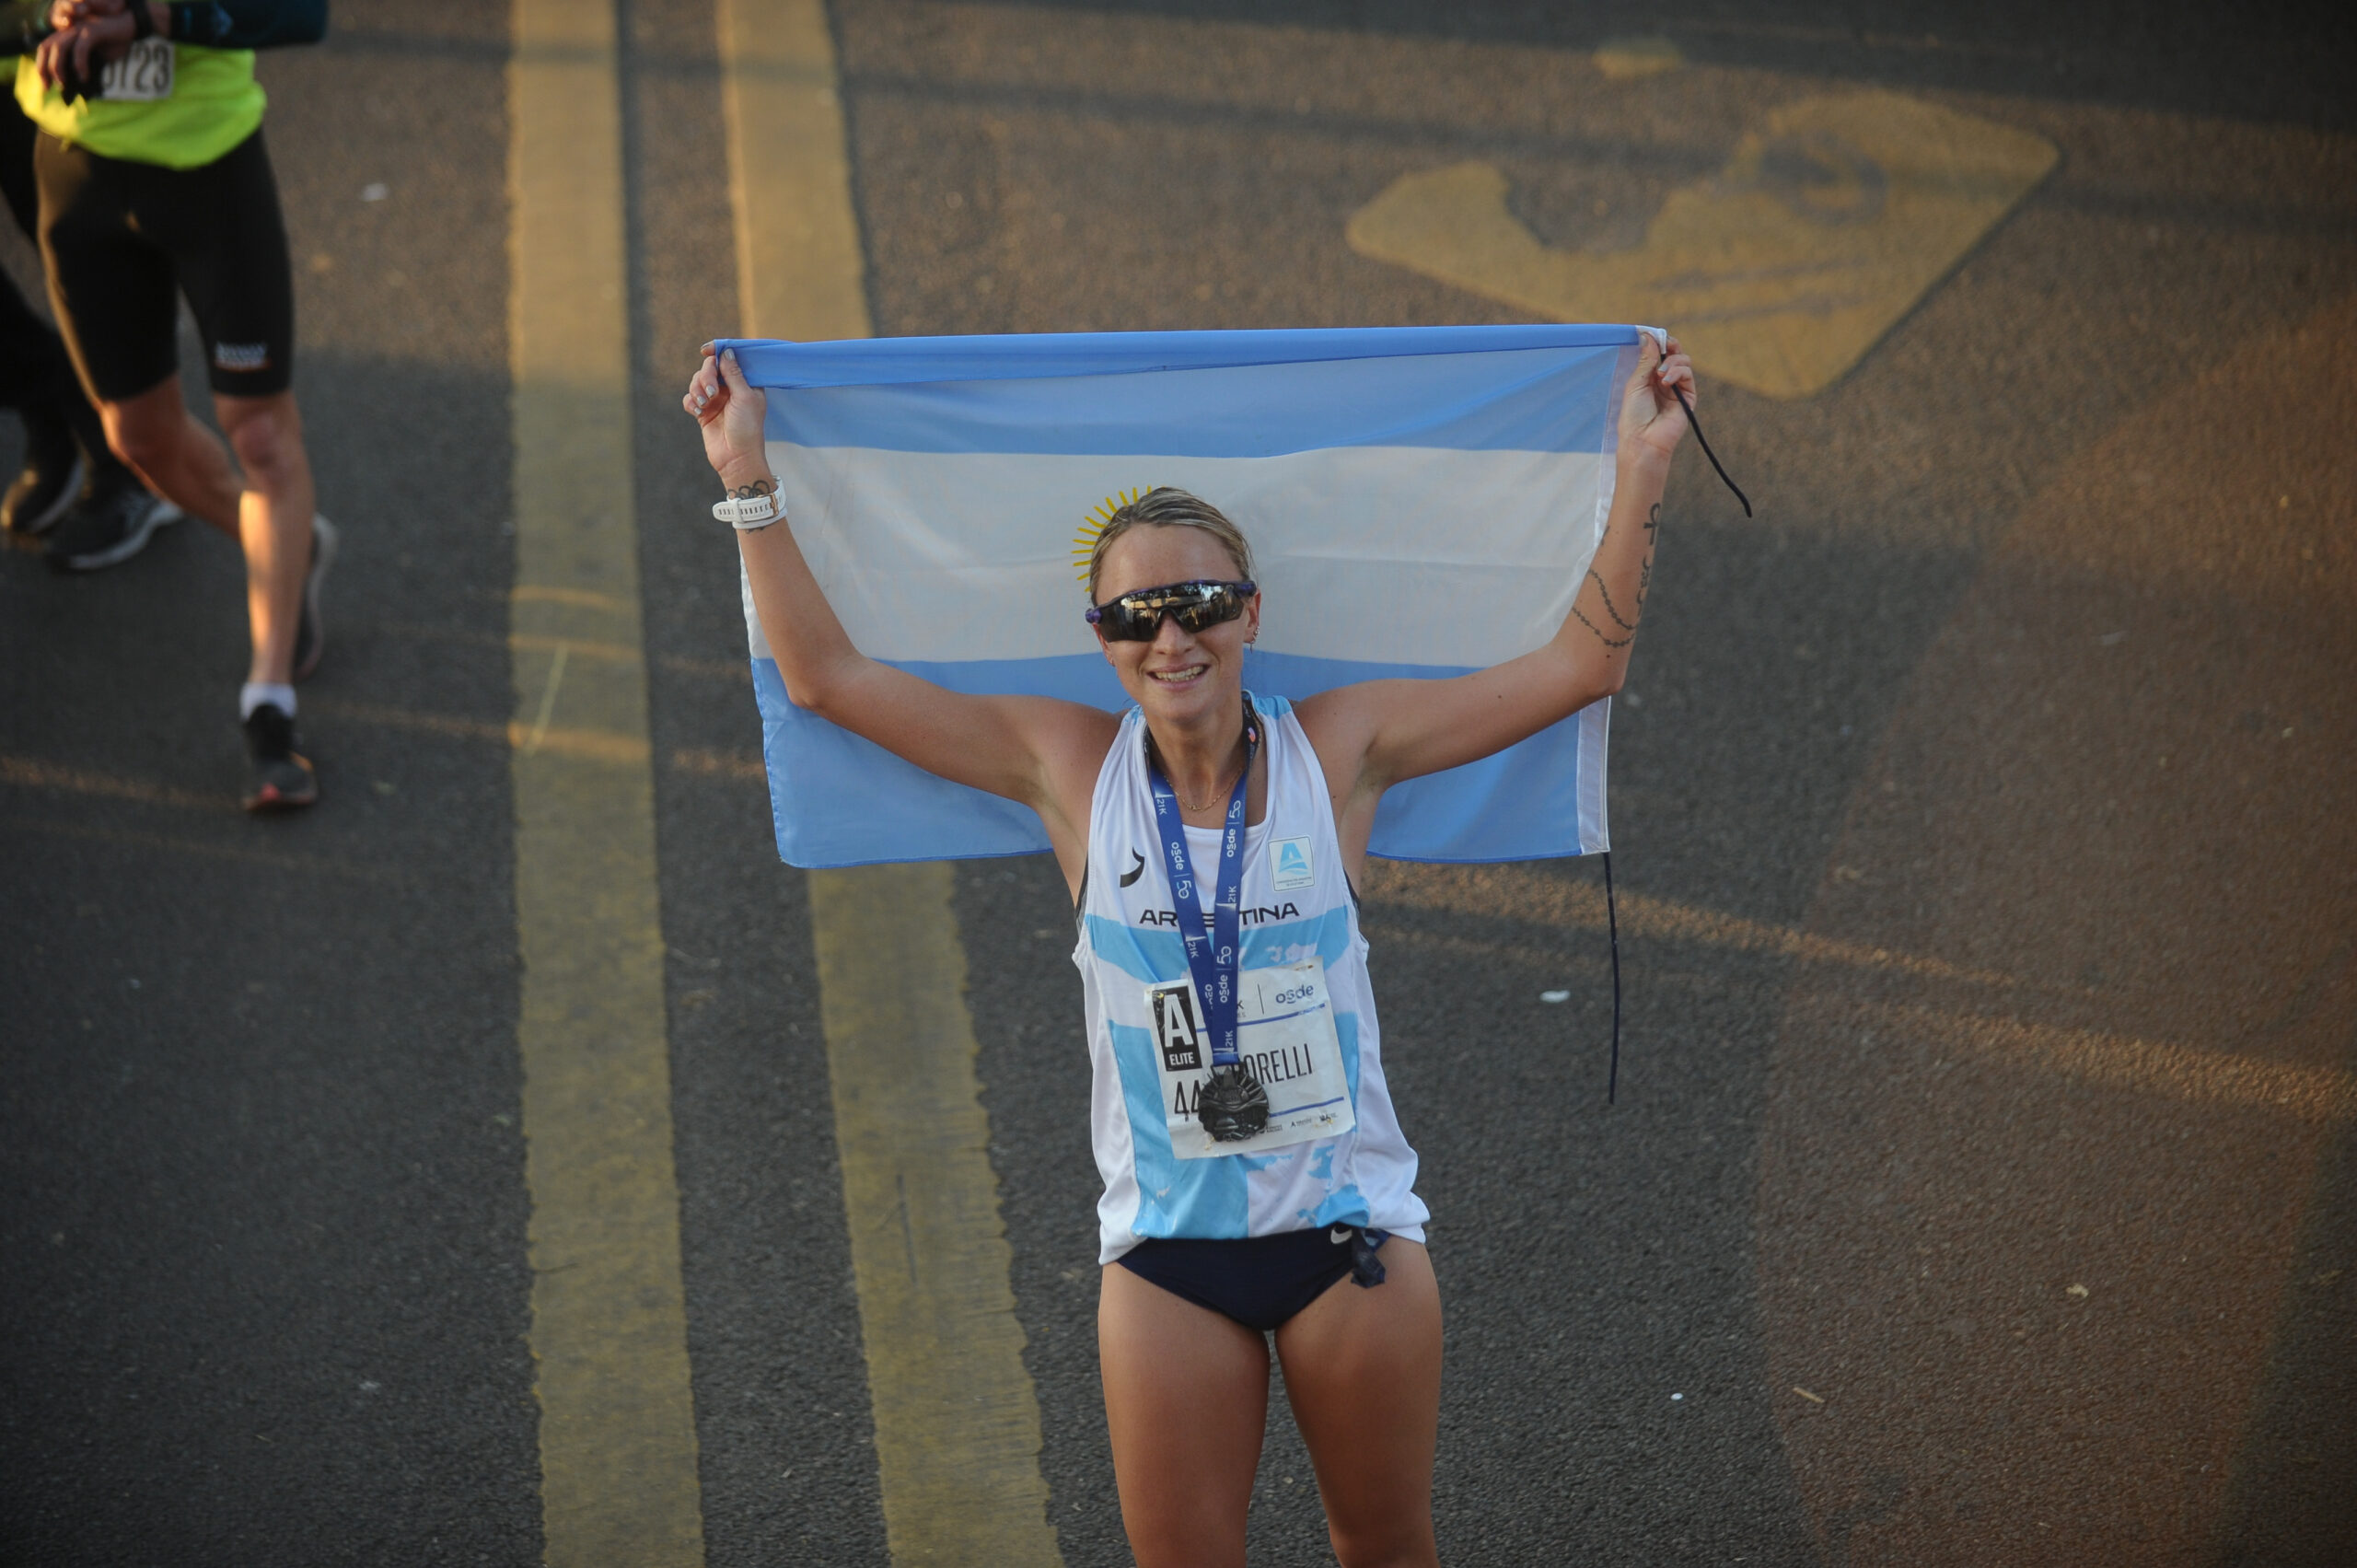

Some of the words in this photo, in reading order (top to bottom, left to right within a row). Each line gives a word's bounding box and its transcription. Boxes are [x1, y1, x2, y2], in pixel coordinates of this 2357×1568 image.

[1157, 798, 1167, 815] 21K
[1226, 829, 1237, 857] osde
[1171, 842, 1185, 870] osde
[1228, 886, 1237, 903] 21K
[1139, 902, 1300, 927] ARETINA
[1188, 941, 1200, 958] 21K
[1218, 974, 1230, 1004] osde
[1275, 983, 1315, 1004] osde
[1163, 993, 1194, 1049] A
[1225, 1030, 1234, 1048] 21K
[1169, 1051, 1195, 1066] ELITE
[1234, 1043, 1313, 1085] ORELLI
